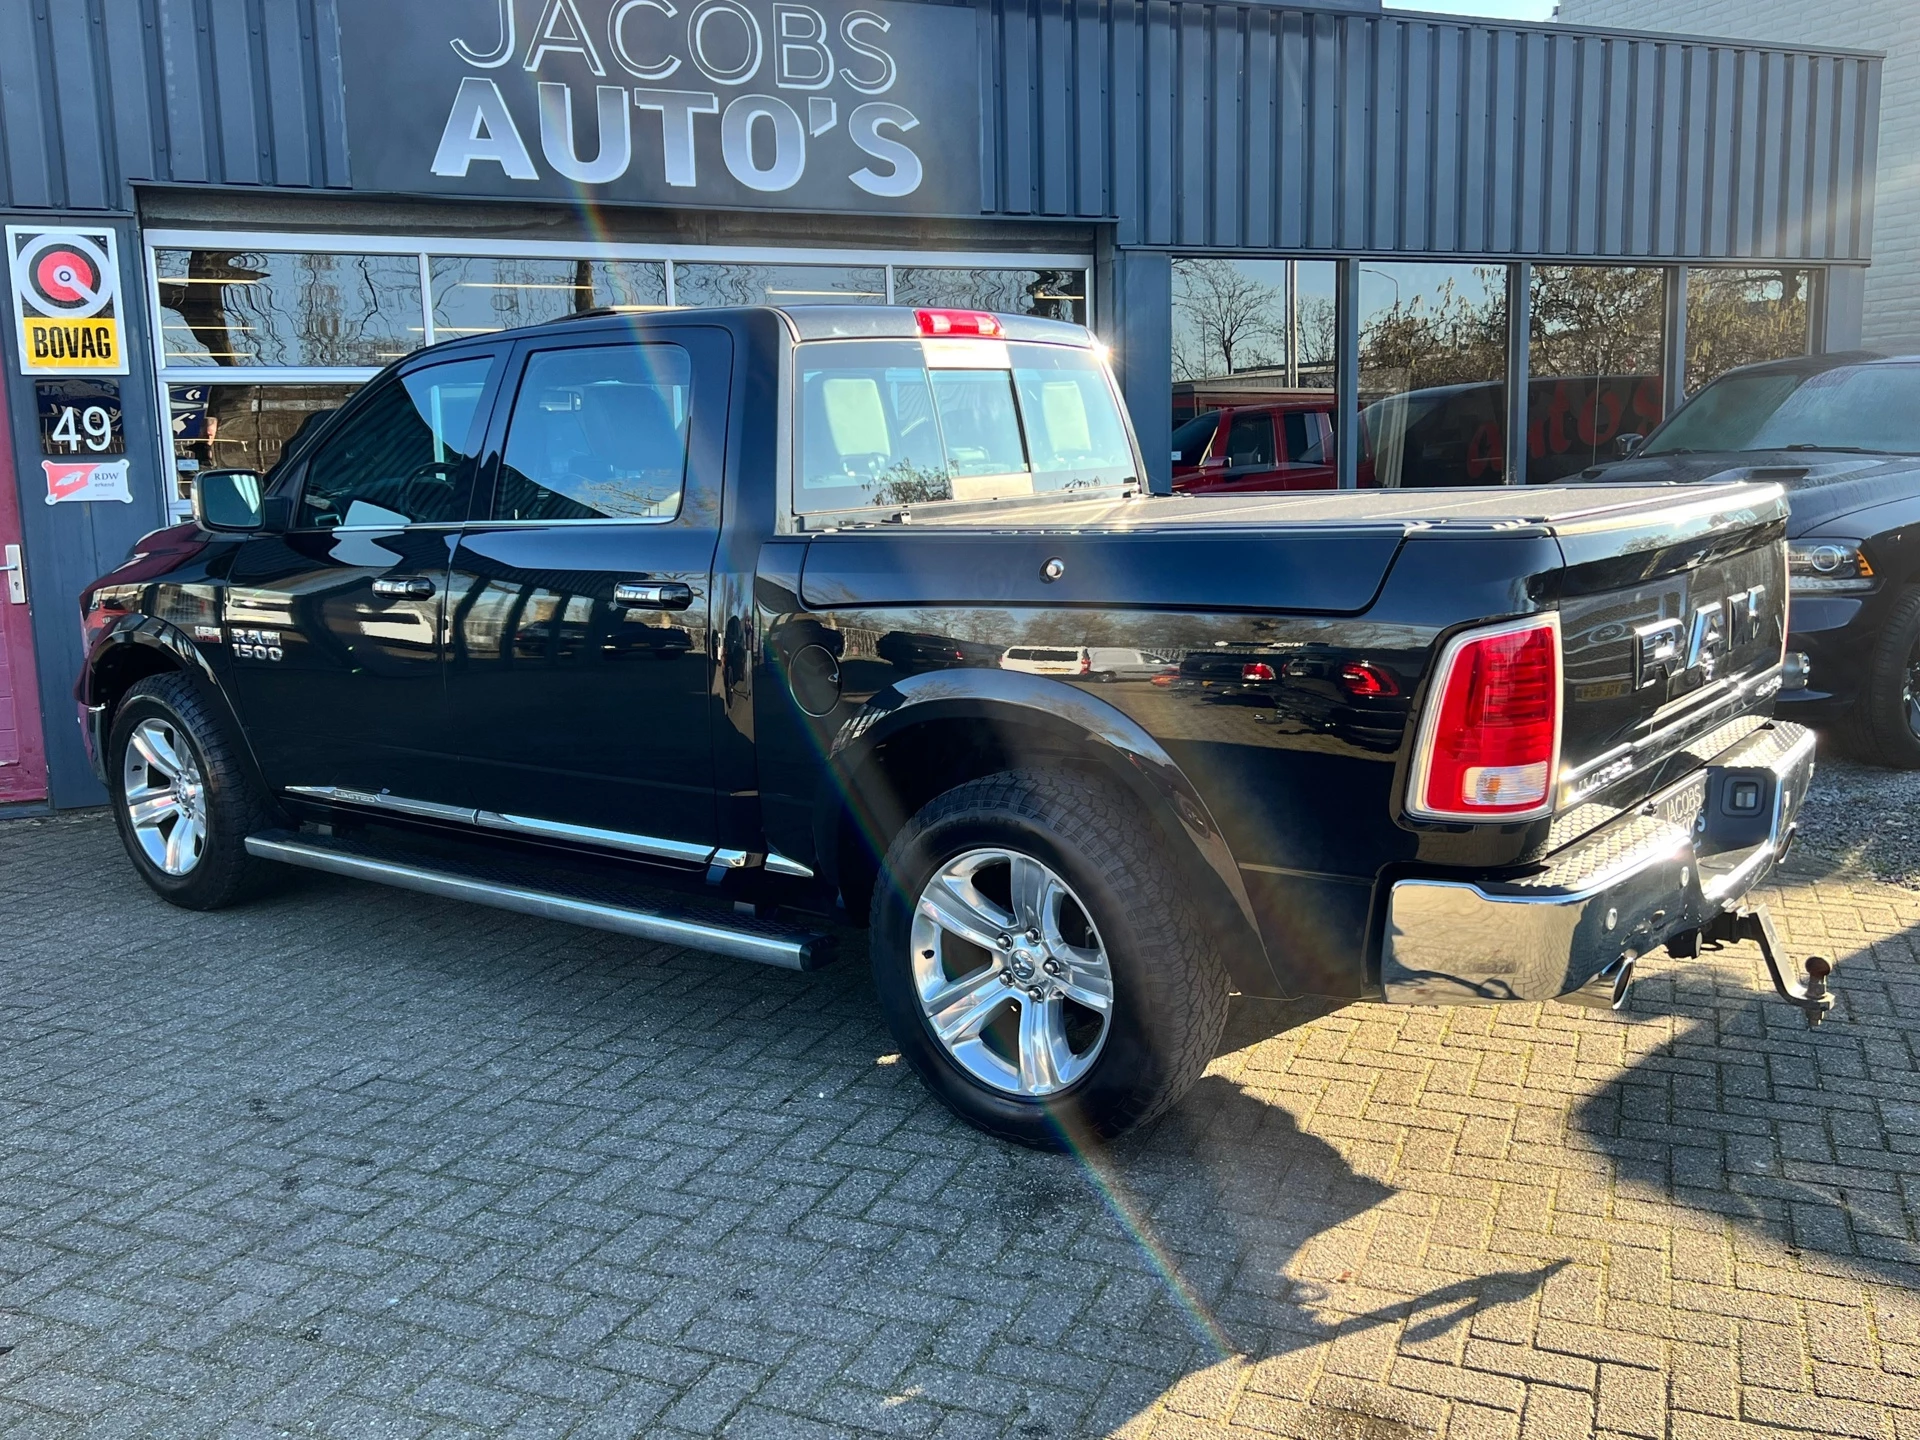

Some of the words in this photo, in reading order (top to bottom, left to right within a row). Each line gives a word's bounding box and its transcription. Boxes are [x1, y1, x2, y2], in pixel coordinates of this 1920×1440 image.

[450, 0, 897, 94] JACOBS
[430, 77, 923, 197] AUTO'S
[33, 326, 112, 359] BOVAG
[52, 406, 112, 451] 49
[94, 472, 119, 481] RDW
[231, 628, 282, 646] RAM
[232, 643, 284, 661] 1500
